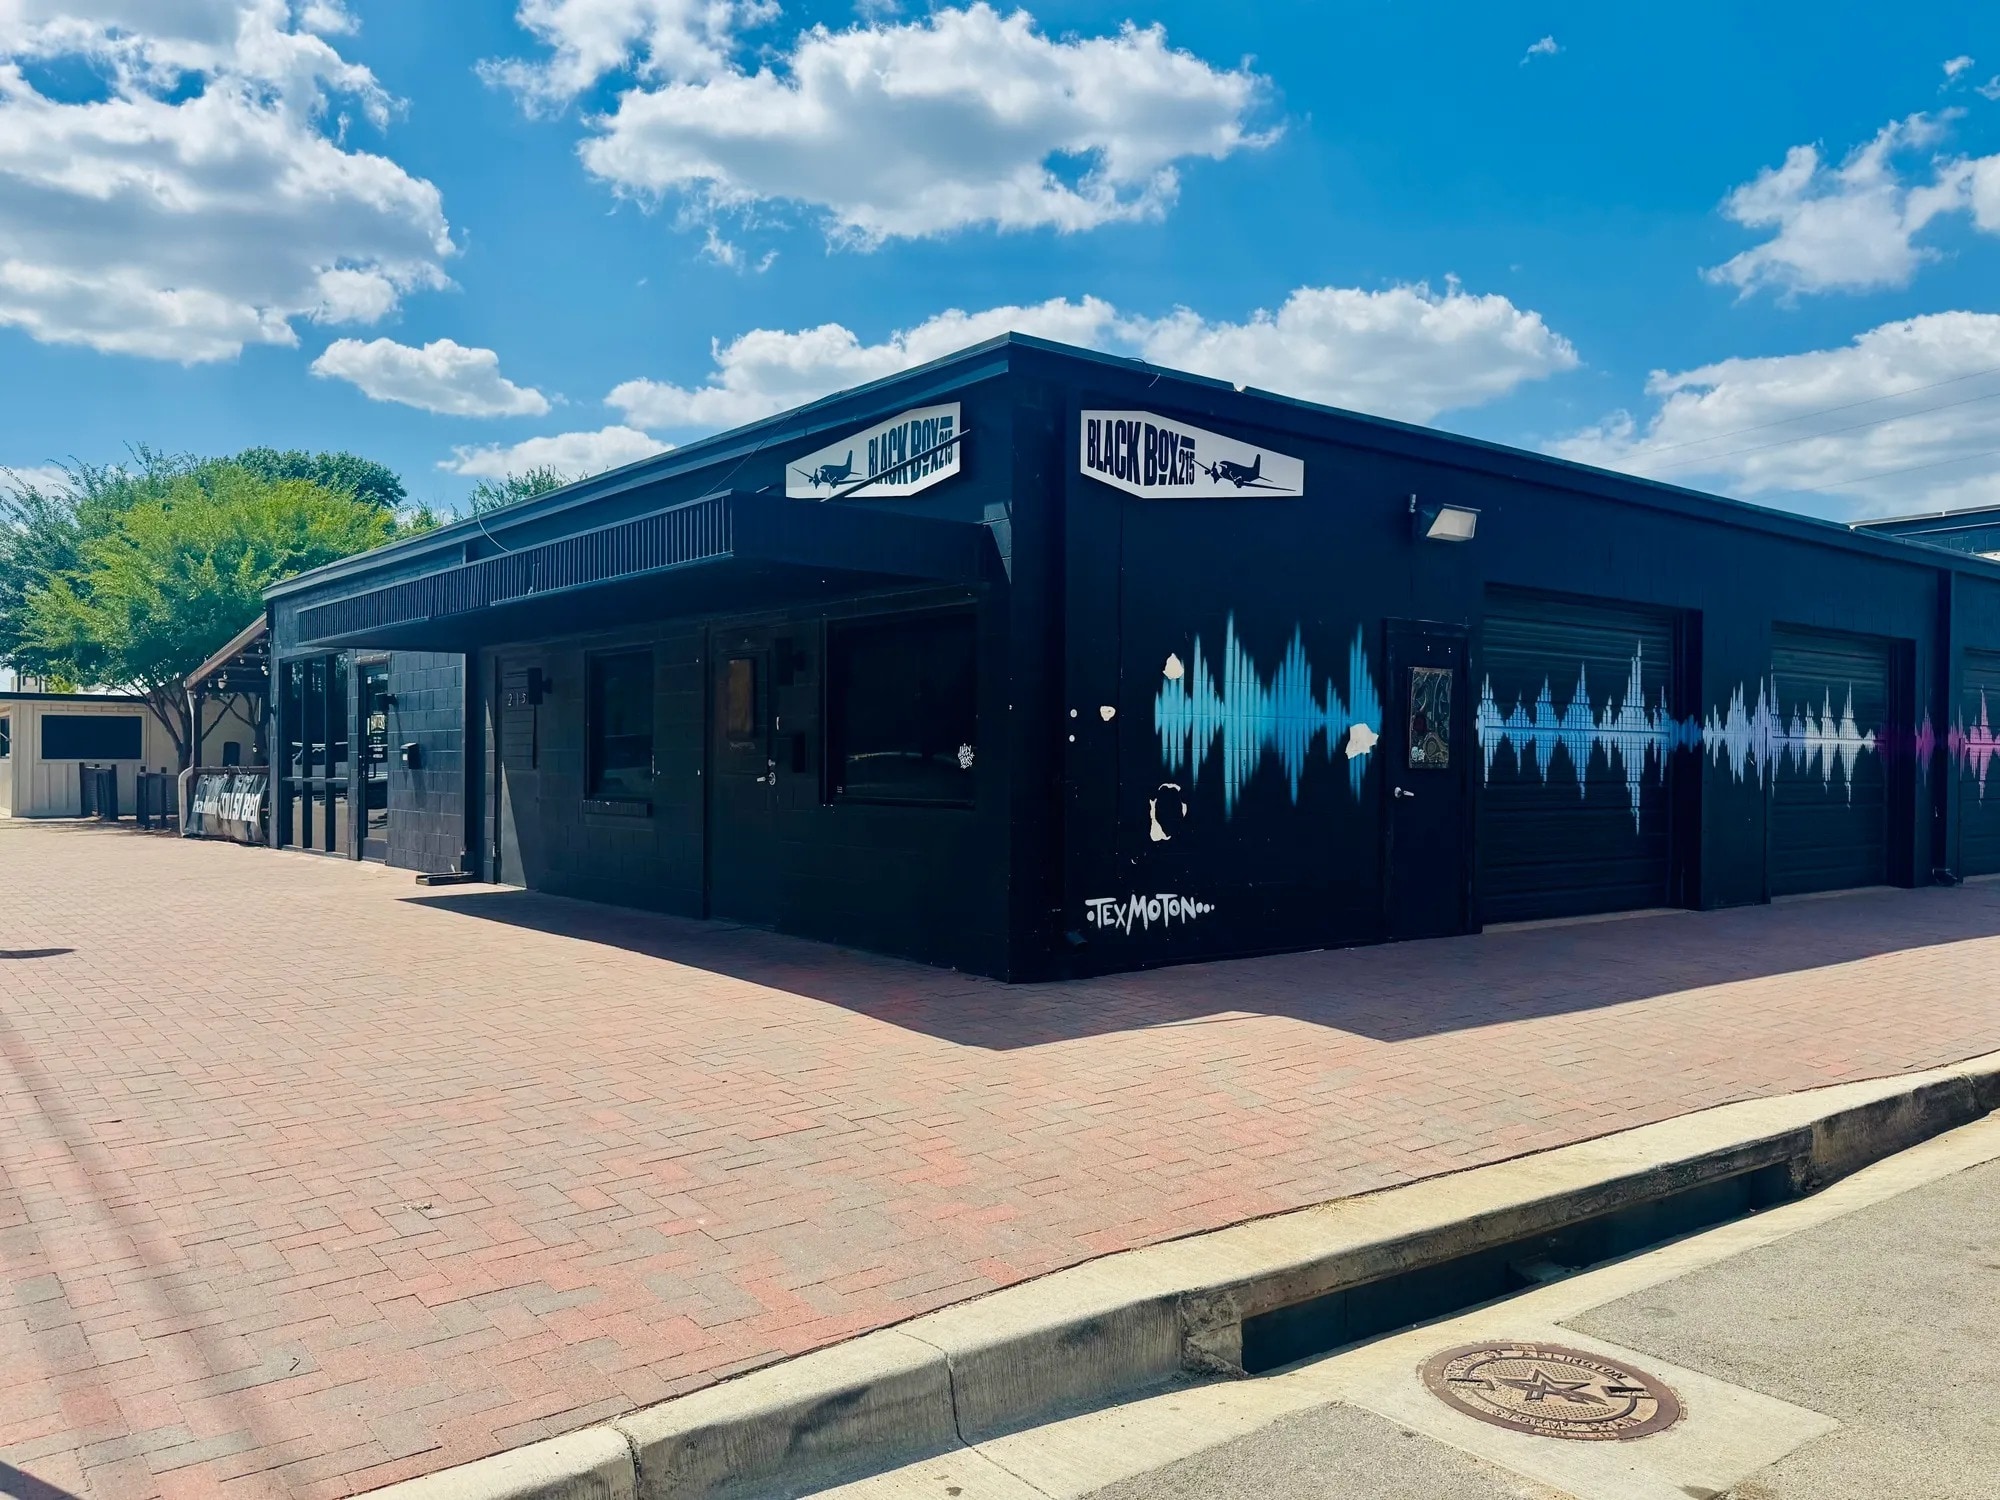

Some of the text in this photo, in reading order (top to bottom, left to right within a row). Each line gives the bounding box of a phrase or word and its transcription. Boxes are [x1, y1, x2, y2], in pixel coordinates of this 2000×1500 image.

[868, 422, 909, 485] BLACK
[1087, 419, 1195, 486] BLACK BOX 215
